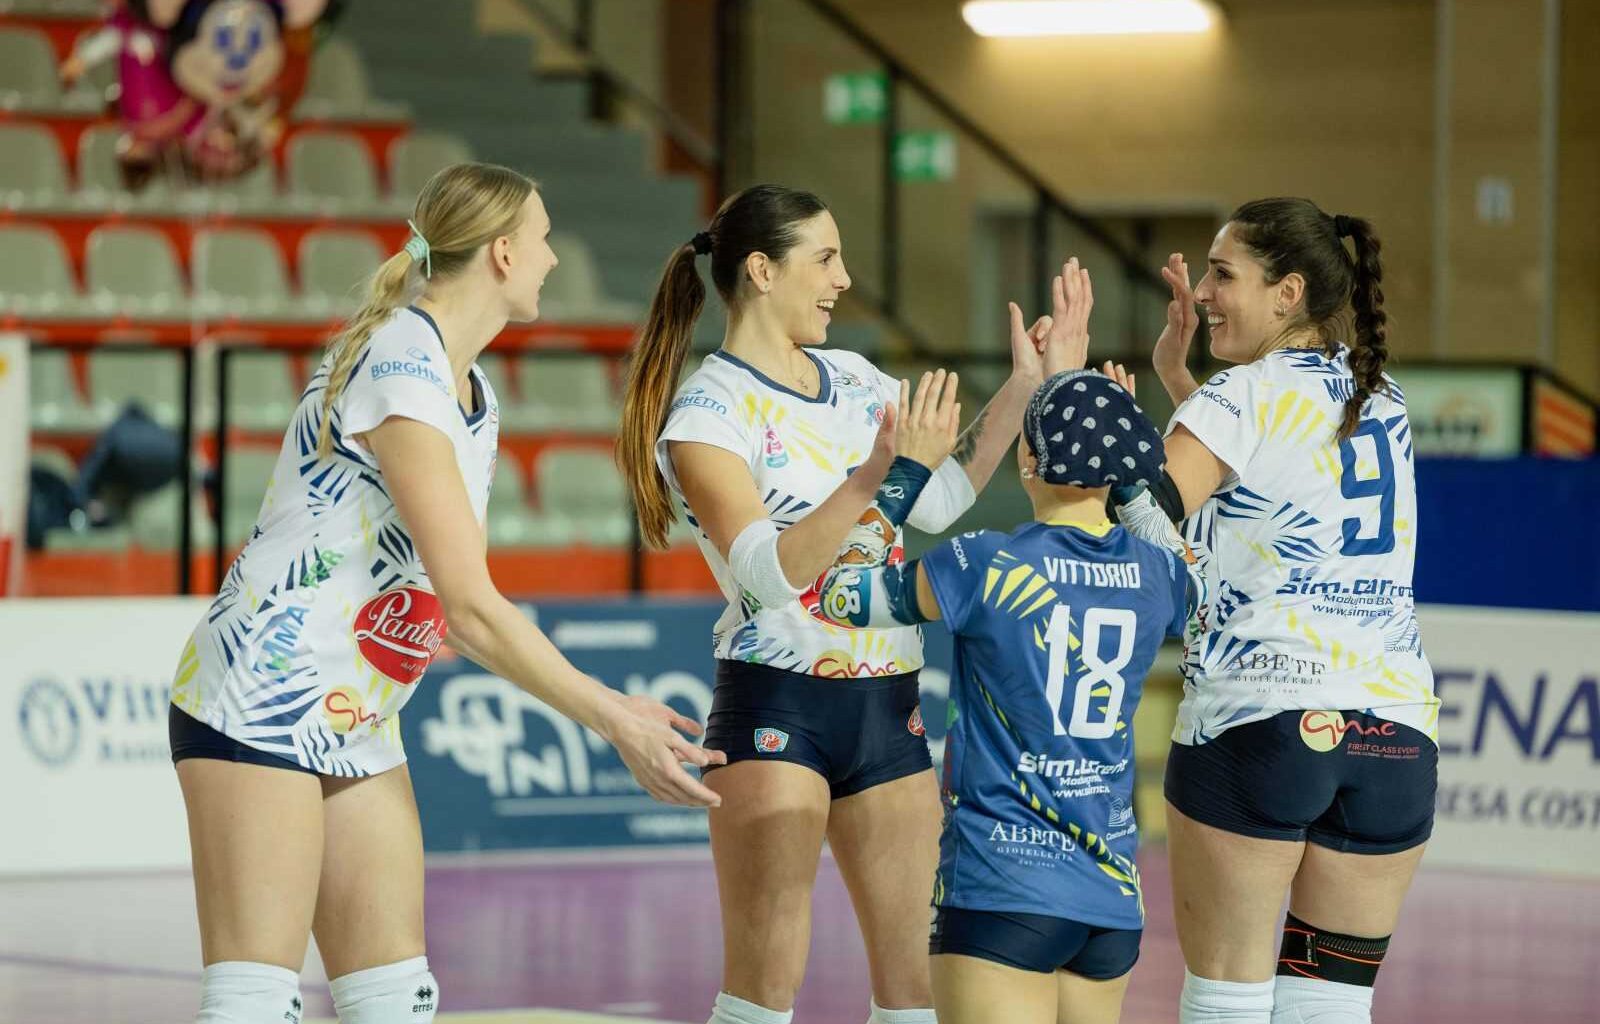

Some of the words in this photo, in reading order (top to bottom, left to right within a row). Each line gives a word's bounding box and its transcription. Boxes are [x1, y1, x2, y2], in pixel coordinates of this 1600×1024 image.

[1339, 418, 1396, 557] 9
[1043, 556, 1141, 589] VITTORIO
[1044, 603, 1137, 740] 18
[1227, 653, 1326, 675] ABETE
[989, 822, 1076, 852] ABETE
